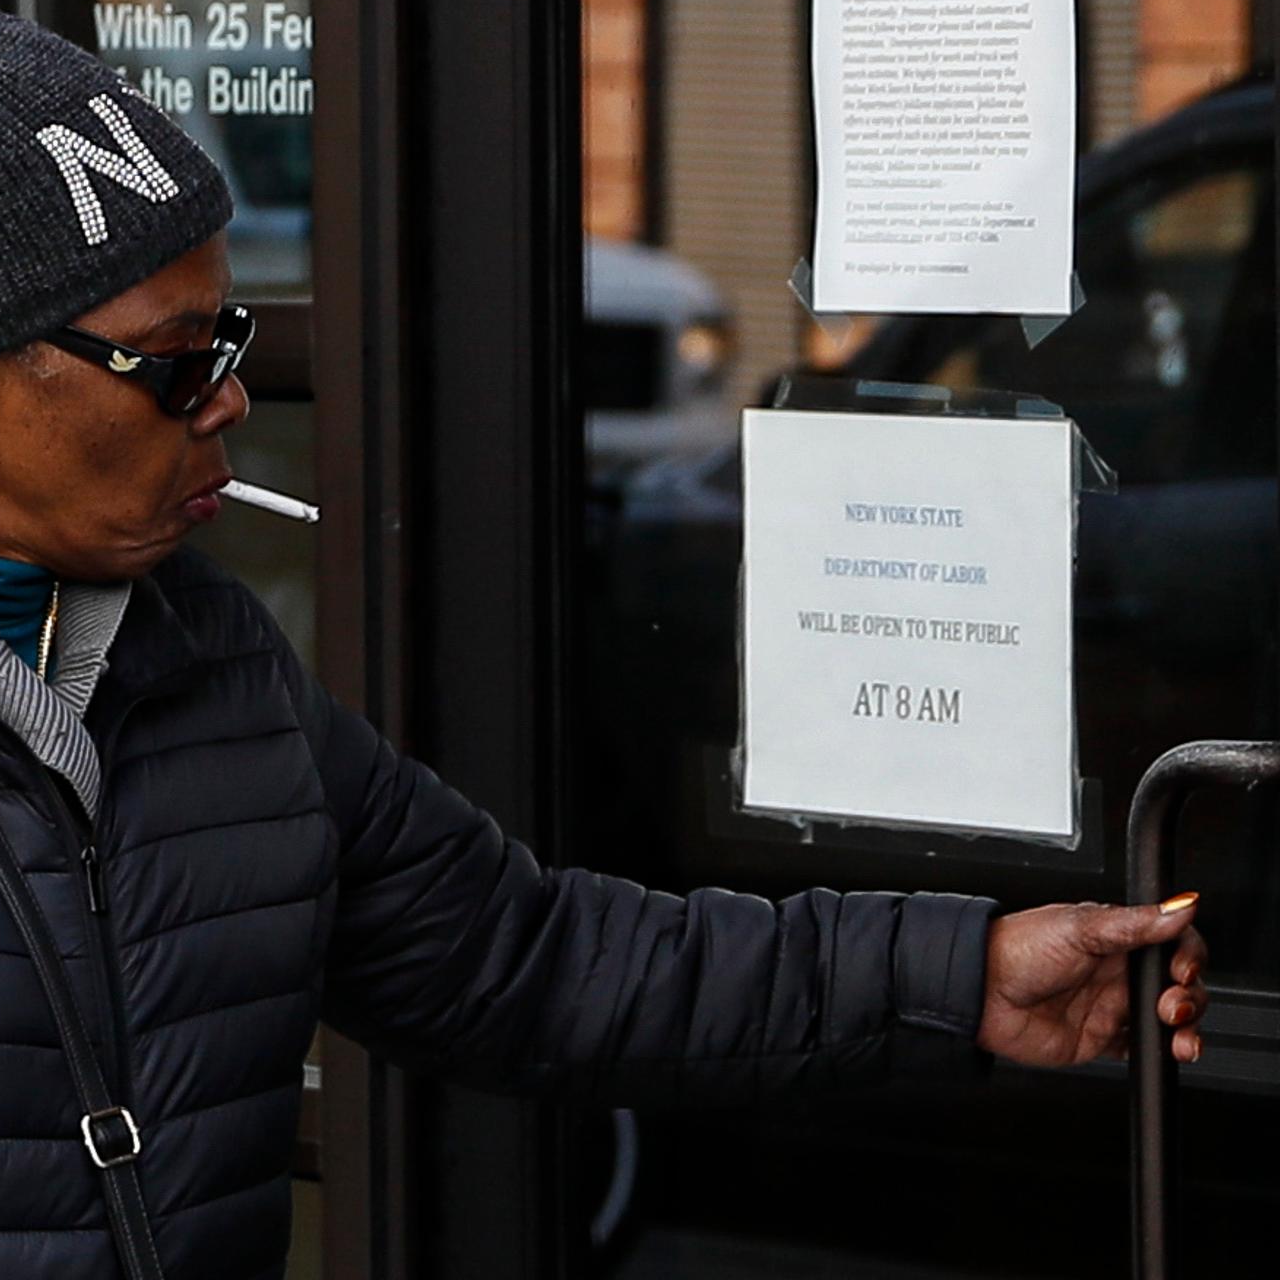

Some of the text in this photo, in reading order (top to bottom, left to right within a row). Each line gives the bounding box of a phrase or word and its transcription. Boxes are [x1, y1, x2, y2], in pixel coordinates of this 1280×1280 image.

[94, 3, 191, 49] Within
[207, 3, 248, 49] 25
[142, 67, 192, 113] the
[36, 93, 180, 246] N
[845, 504, 964, 527] NEW YORK STATE
[825, 558, 987, 585] DEPARTMENT OF LABOR
[798, 612, 1020, 645] WILL BE OPEN TO THE PUBLIC
[853, 682, 961, 723] AT 8 AM
